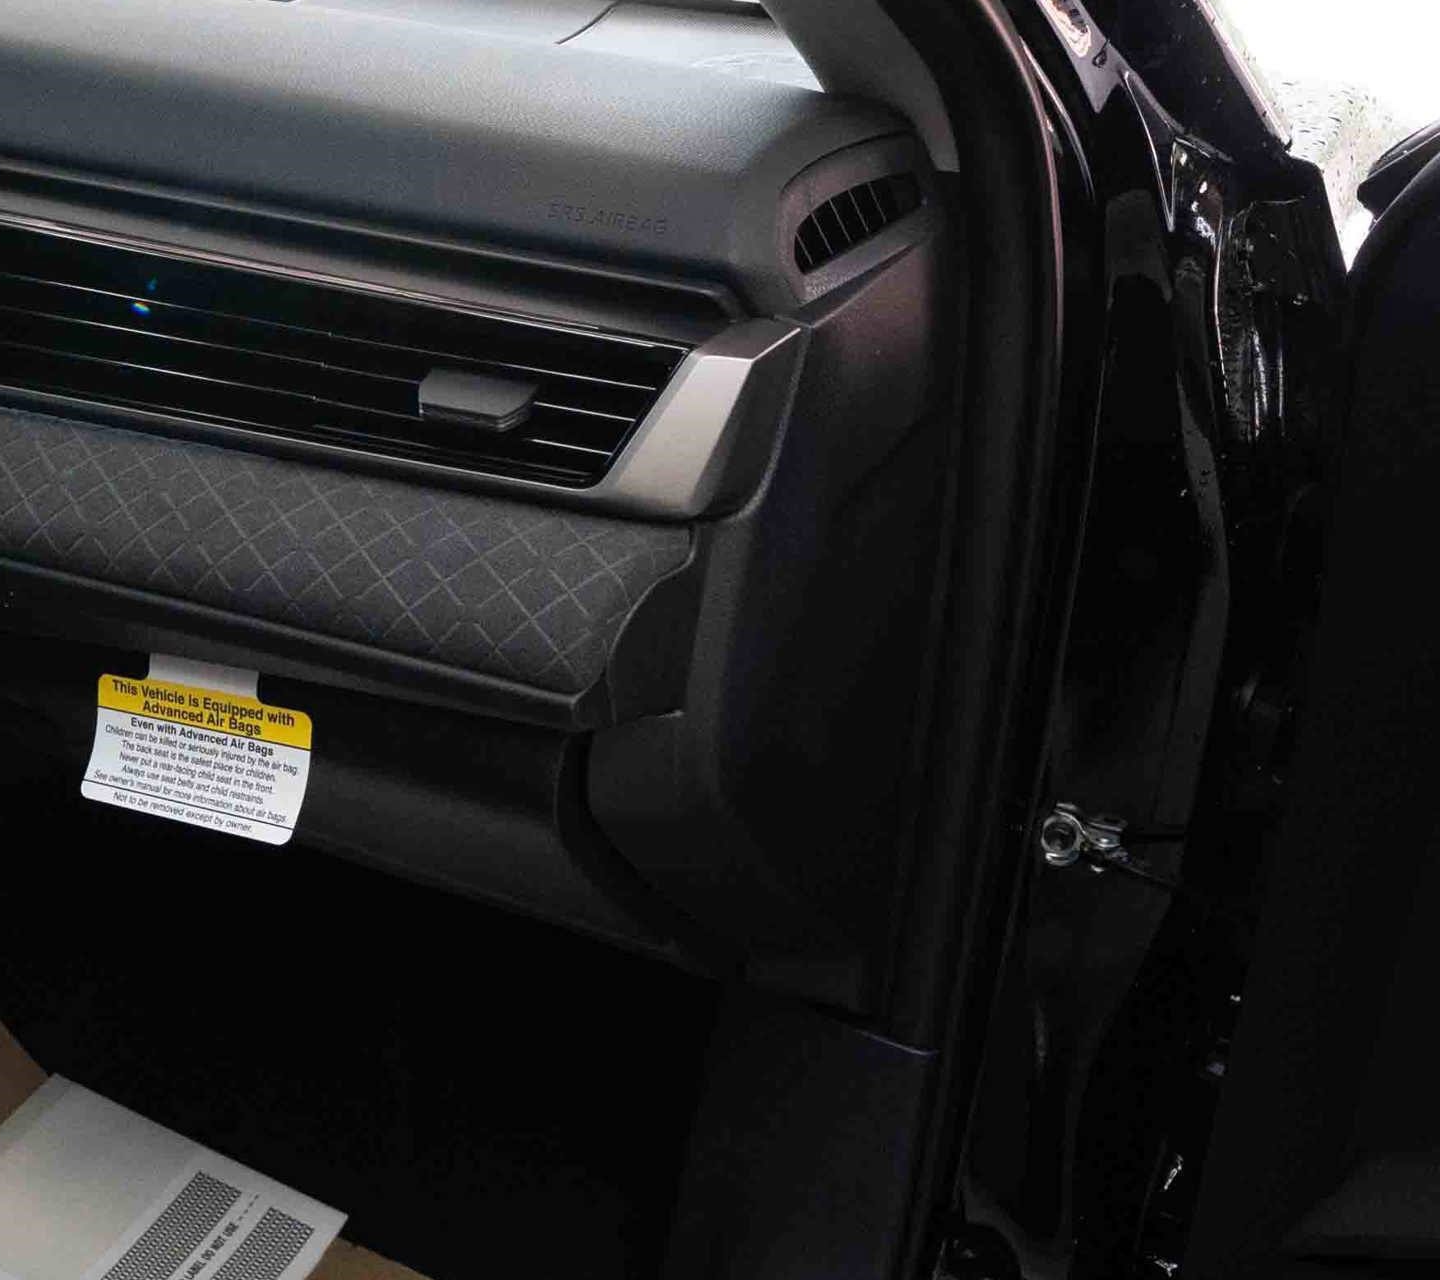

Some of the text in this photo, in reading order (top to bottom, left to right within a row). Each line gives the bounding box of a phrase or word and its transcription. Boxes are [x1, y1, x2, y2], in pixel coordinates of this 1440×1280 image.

[112, 679, 138, 696] This
[141, 685, 185, 705] Vehicle
[203, 697, 263, 721] Equipped
[268, 712, 295, 727] with
[143, 700, 262, 736] Advanced Air Bags
[105, 724, 134, 738] Children
[135, 731, 148, 741] can
[149, 733, 158, 744] be
[159, 736, 178, 747] killed
[188, 742, 220, 759] seriously
[221, 750, 246, 764] injured
[247, 754, 257, 766] by
[258, 756, 270, 768] the
[130, 717, 274, 757] Even with Advanced Air Bags
[119, 752, 138, 764] Never
[140, 757, 152, 768] put
[122, 739, 135, 751] The
[136, 742, 152, 754] back
[154, 747, 169, 757] seat
[178, 752, 190, 763] the
[214, 760, 234, 773] place
[122, 764, 146, 778] Always
[94, 768, 108, 781] See
[113, 791, 127, 804] Not
[128, 794, 137, 805] to
[137, 798, 149, 808] be
[150, 800, 185, 818] removed
[185, 808, 214, 827] except
[214, 815, 224, 827] by
